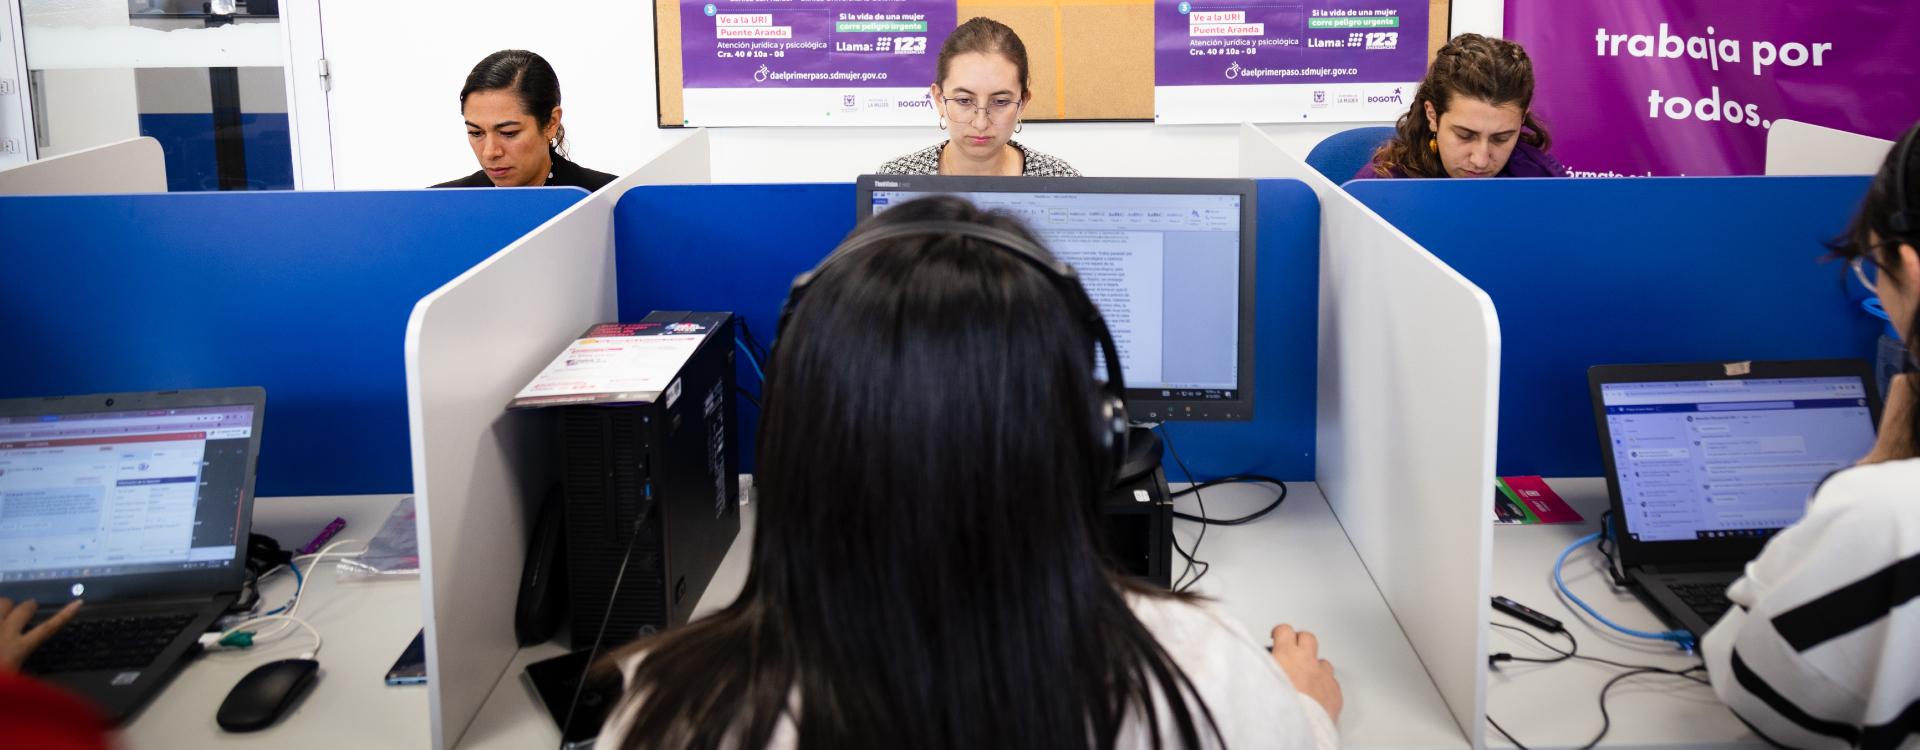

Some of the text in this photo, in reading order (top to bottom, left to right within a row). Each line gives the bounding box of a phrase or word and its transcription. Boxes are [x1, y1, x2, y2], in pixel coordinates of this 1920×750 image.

[902, 13, 924, 21] mujer
[1375, 9, 1397, 17] mujer
[862, 23, 890, 31] peligro
[1334, 19, 1362, 27] peligro
[836, 37, 926, 51] Llama: 123
[1224, 39, 1251, 47] jurídica
[1258, 38, 1298, 46] psicológica
[1308, 32, 1398, 48] Llama: 123
[751, 41, 778, 50] jurídica
[786, 41, 827, 50] psicológica
[1596, 23, 1832, 75] trabaja por
[770, 71, 887, 81] daelprimerpaso.sdmujer.gov.co
[1241, 66, 1357, 78] daelprimerpaso.sdmujer.gov.co
[1648, 86, 1771, 129] todos.
